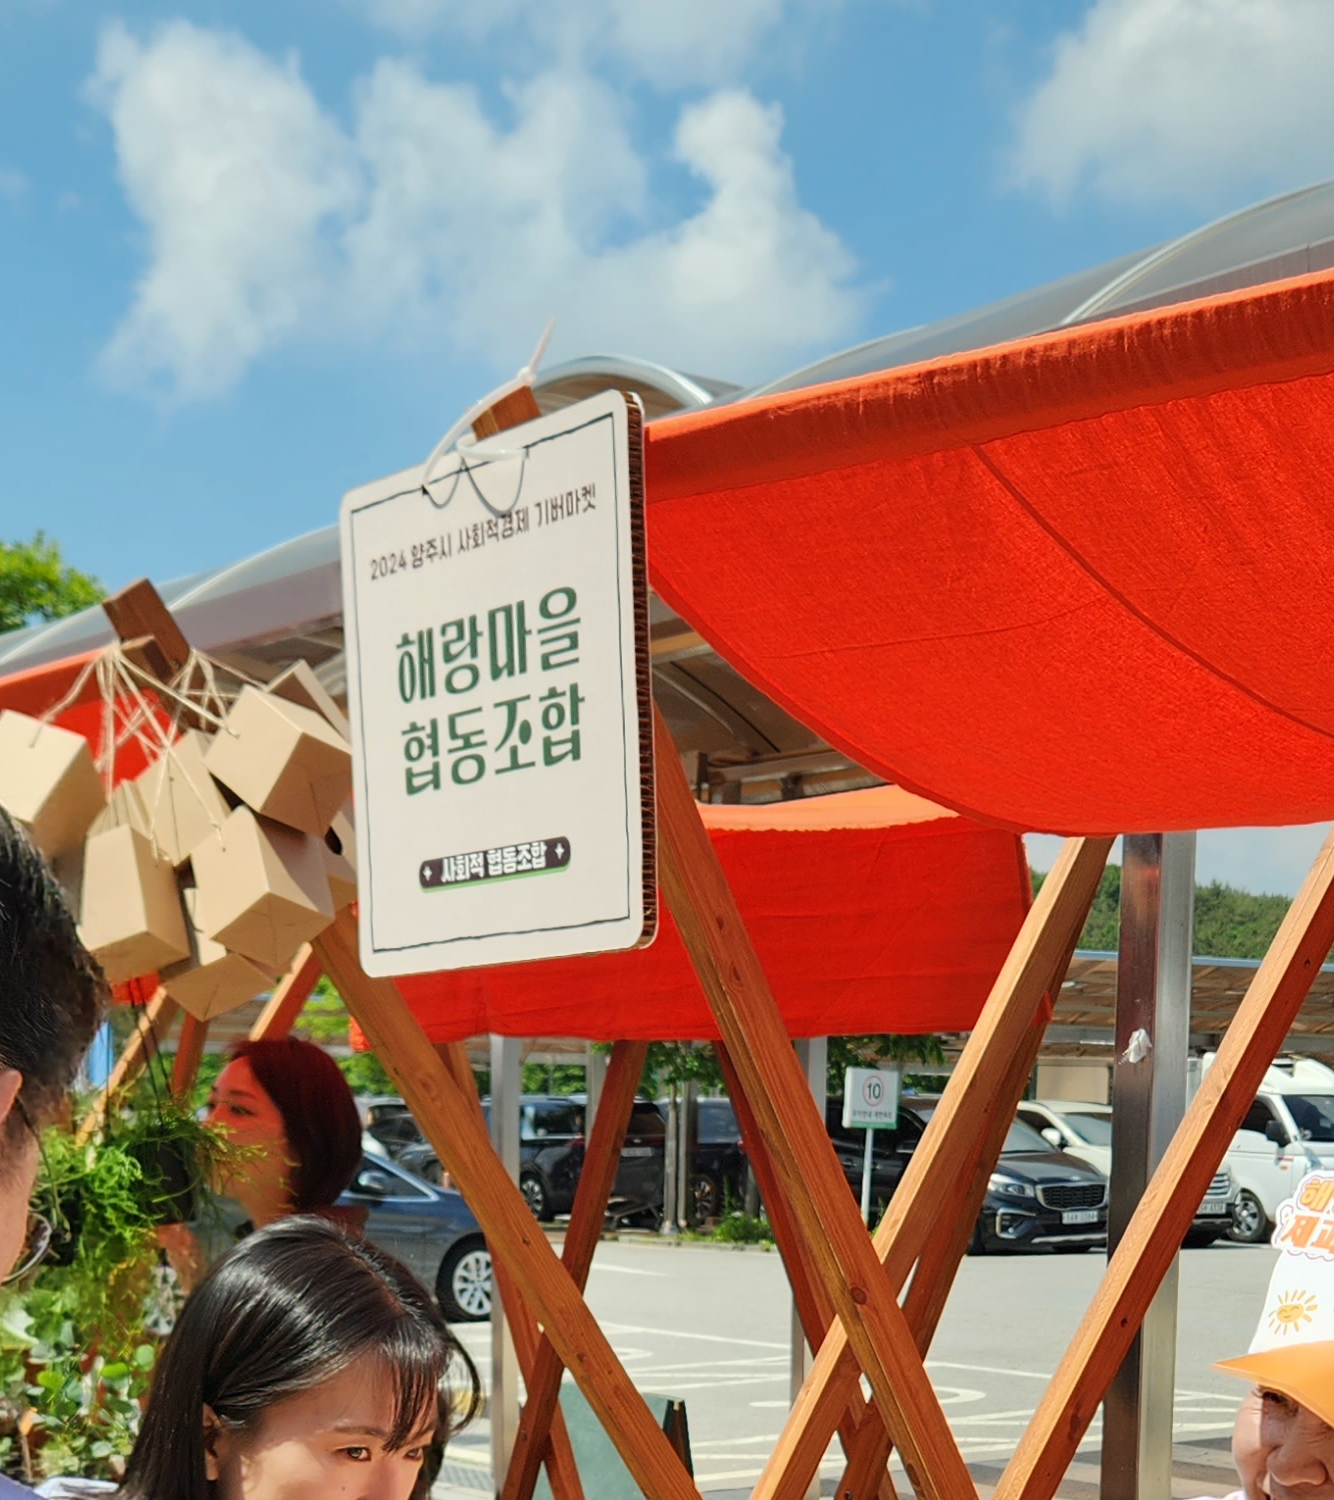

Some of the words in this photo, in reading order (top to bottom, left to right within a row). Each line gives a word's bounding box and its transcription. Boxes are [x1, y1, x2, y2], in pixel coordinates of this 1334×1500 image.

[371, 551, 406, 580] 2024
[412, 532, 452, 569] 양주시
[457, 506, 530, 553] 사회적경제
[535, 483, 596, 527] 기버마켓
[396, 586, 581, 704] 해랑마을
[401, 682, 585, 796] 협동조합
[441, 852, 485, 883] 사회적
[487, 841, 547, 876] 협동조합
[867, 1083, 881, 1099] 10
